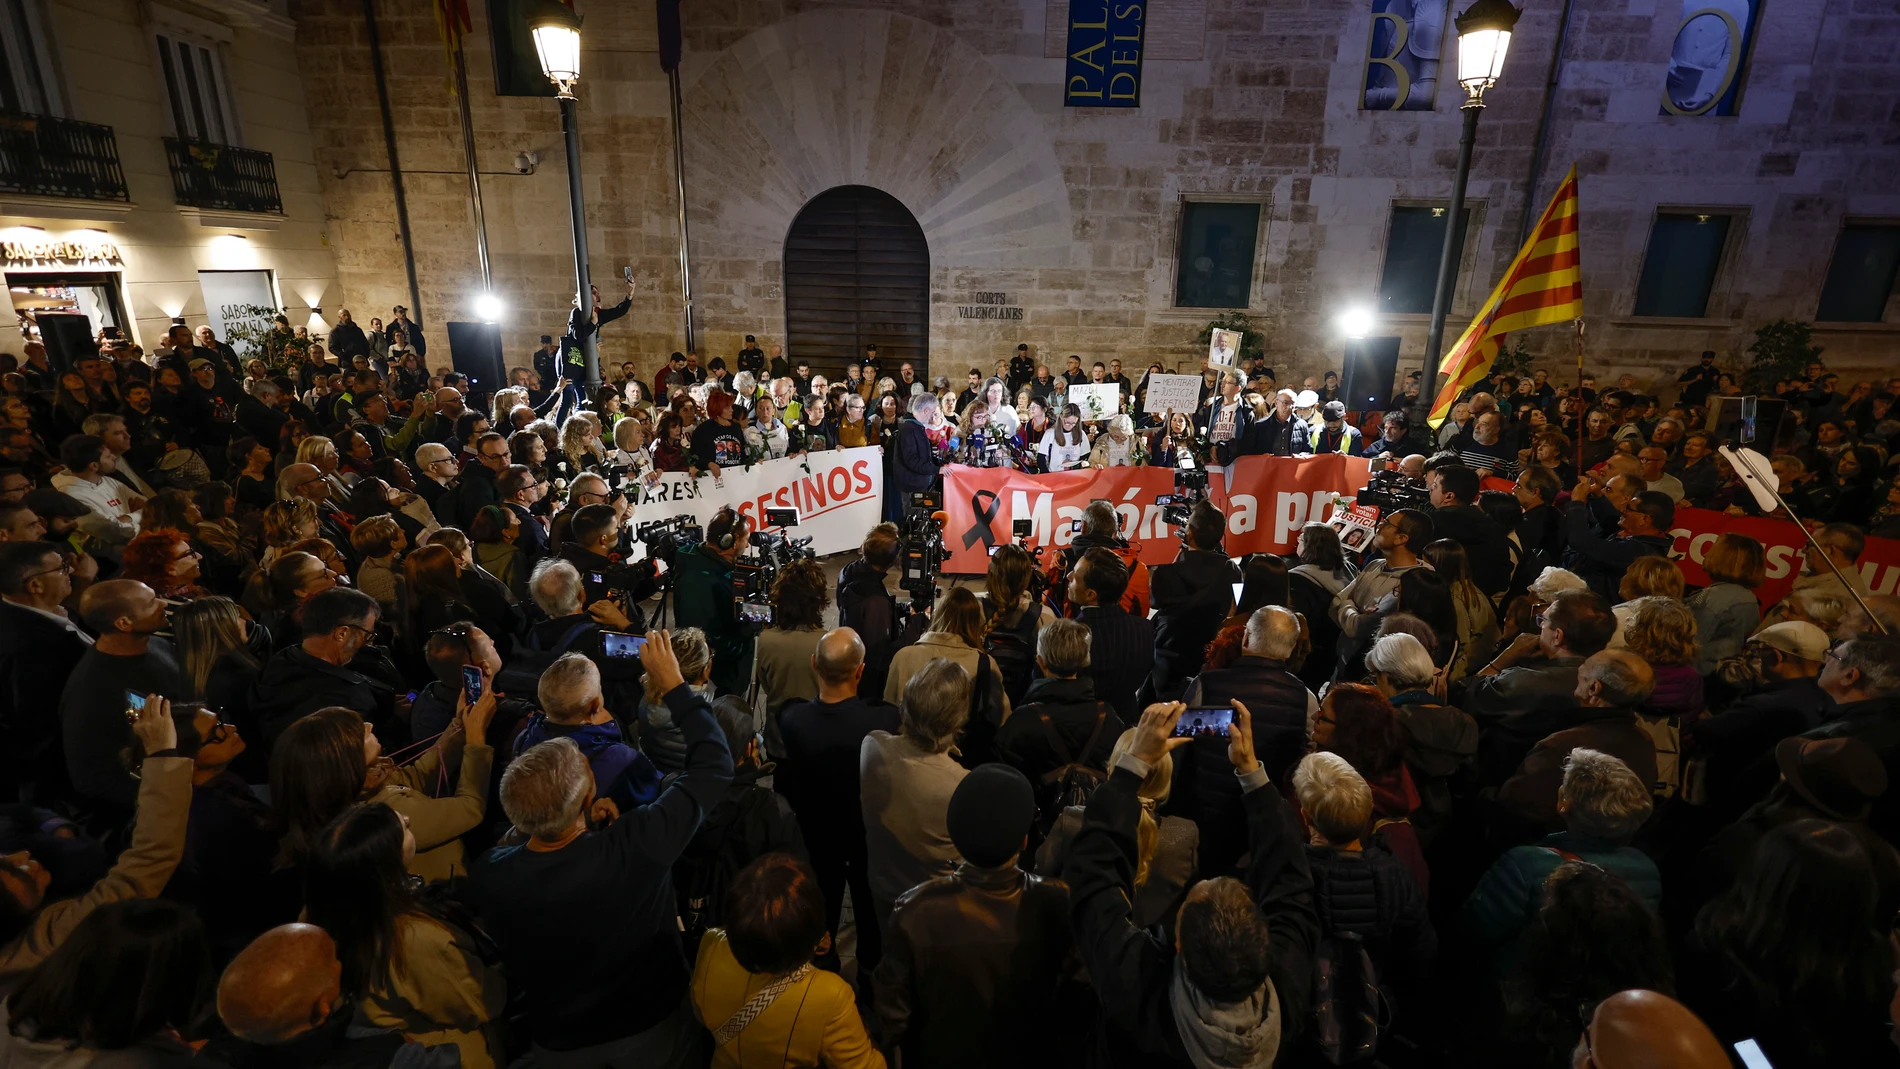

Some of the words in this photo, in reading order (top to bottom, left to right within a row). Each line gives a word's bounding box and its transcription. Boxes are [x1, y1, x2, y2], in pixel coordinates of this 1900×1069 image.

[1068, 0, 1109, 101] PAL
[1109, 4, 1143, 101] DELS
[1358, 12, 1410, 111] B
[1660, 8, 1742, 116] O
[975, 291, 1006, 306] CORTS
[221, 303, 255, 321] SABOR
[958, 306, 1024, 320] VALENCIANES
[223, 319, 265, 338] ESPAÑA
[1162, 378, 1196, 387] MENTIRAS
[1160, 387, 1195, 398] JUSTICIA
[1151, 398, 1196, 409] ASESINOS
[719, 459, 873, 534] SESINOS
[1011, 487, 1168, 547] Maón
